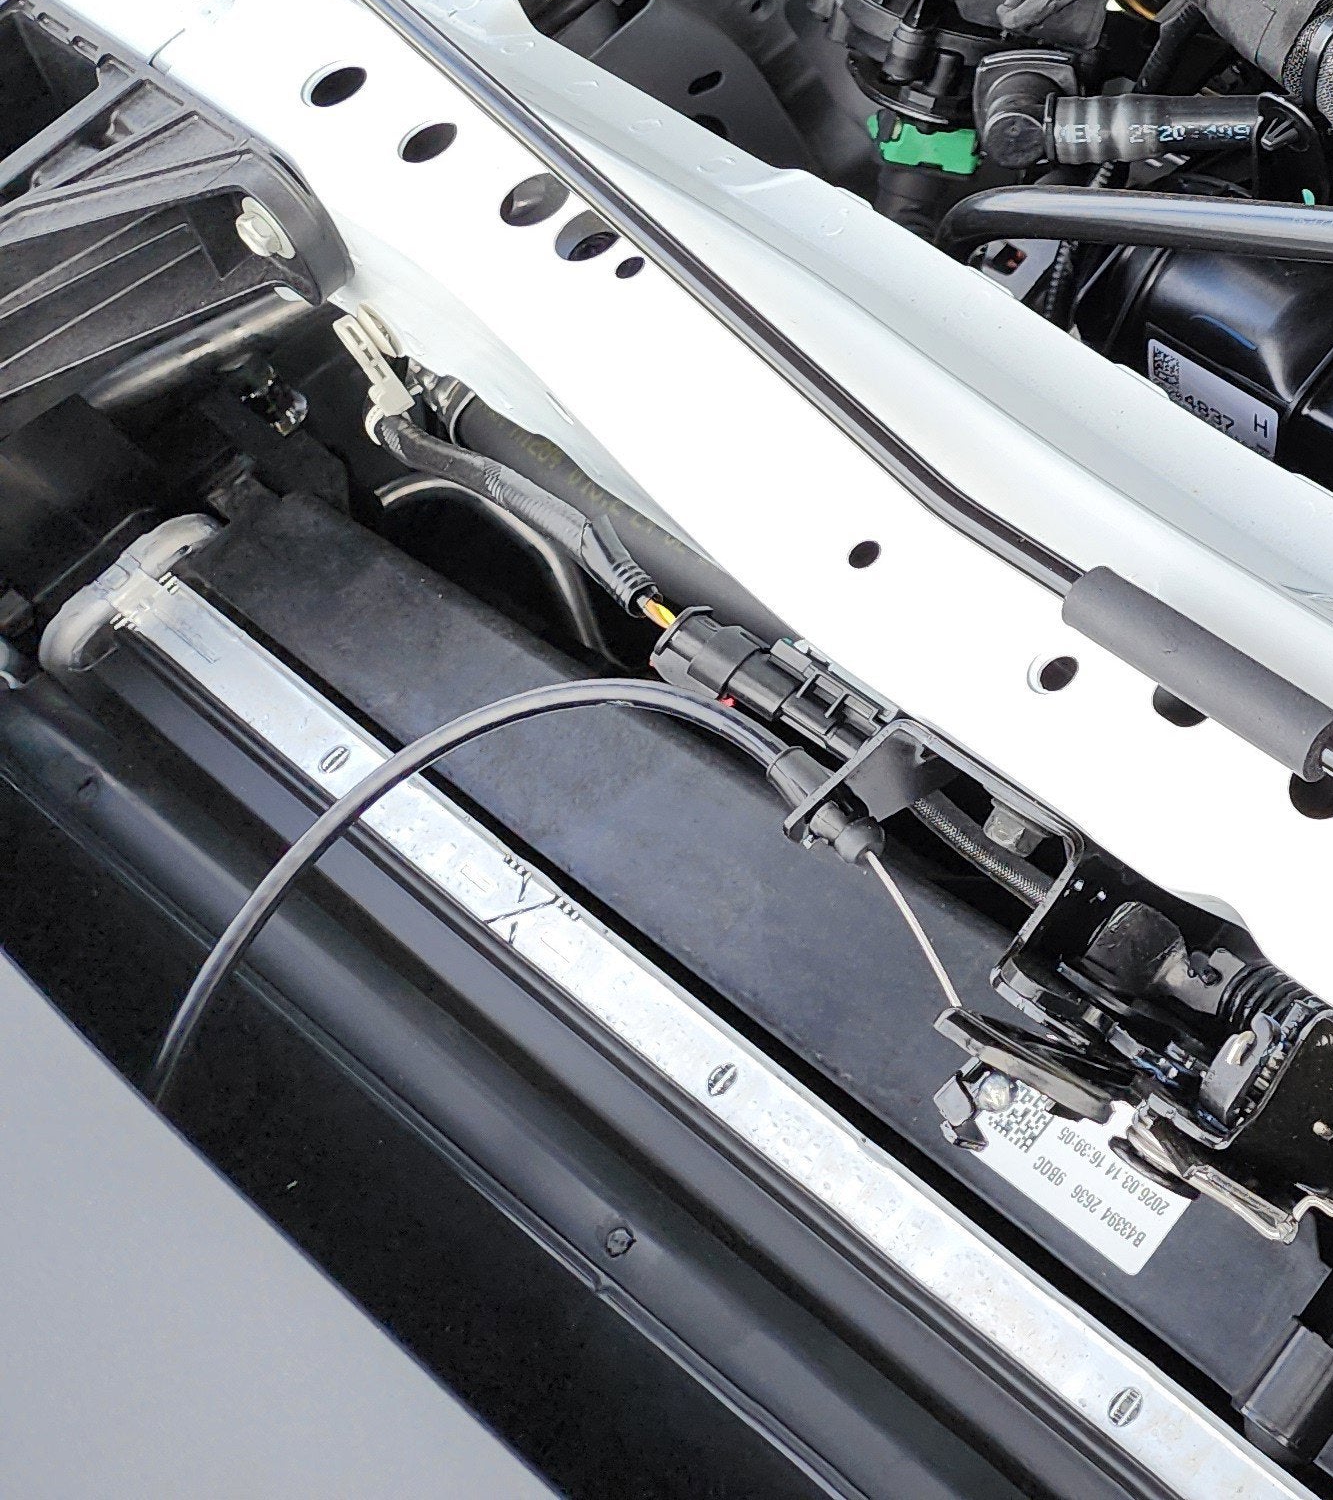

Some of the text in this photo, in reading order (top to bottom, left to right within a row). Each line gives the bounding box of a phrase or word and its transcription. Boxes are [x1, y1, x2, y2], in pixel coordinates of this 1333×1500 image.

[1057, 1126, 1170, 1216] 2026.03.14 16:39:05
[1070, 1184, 1103, 1213] 2636
